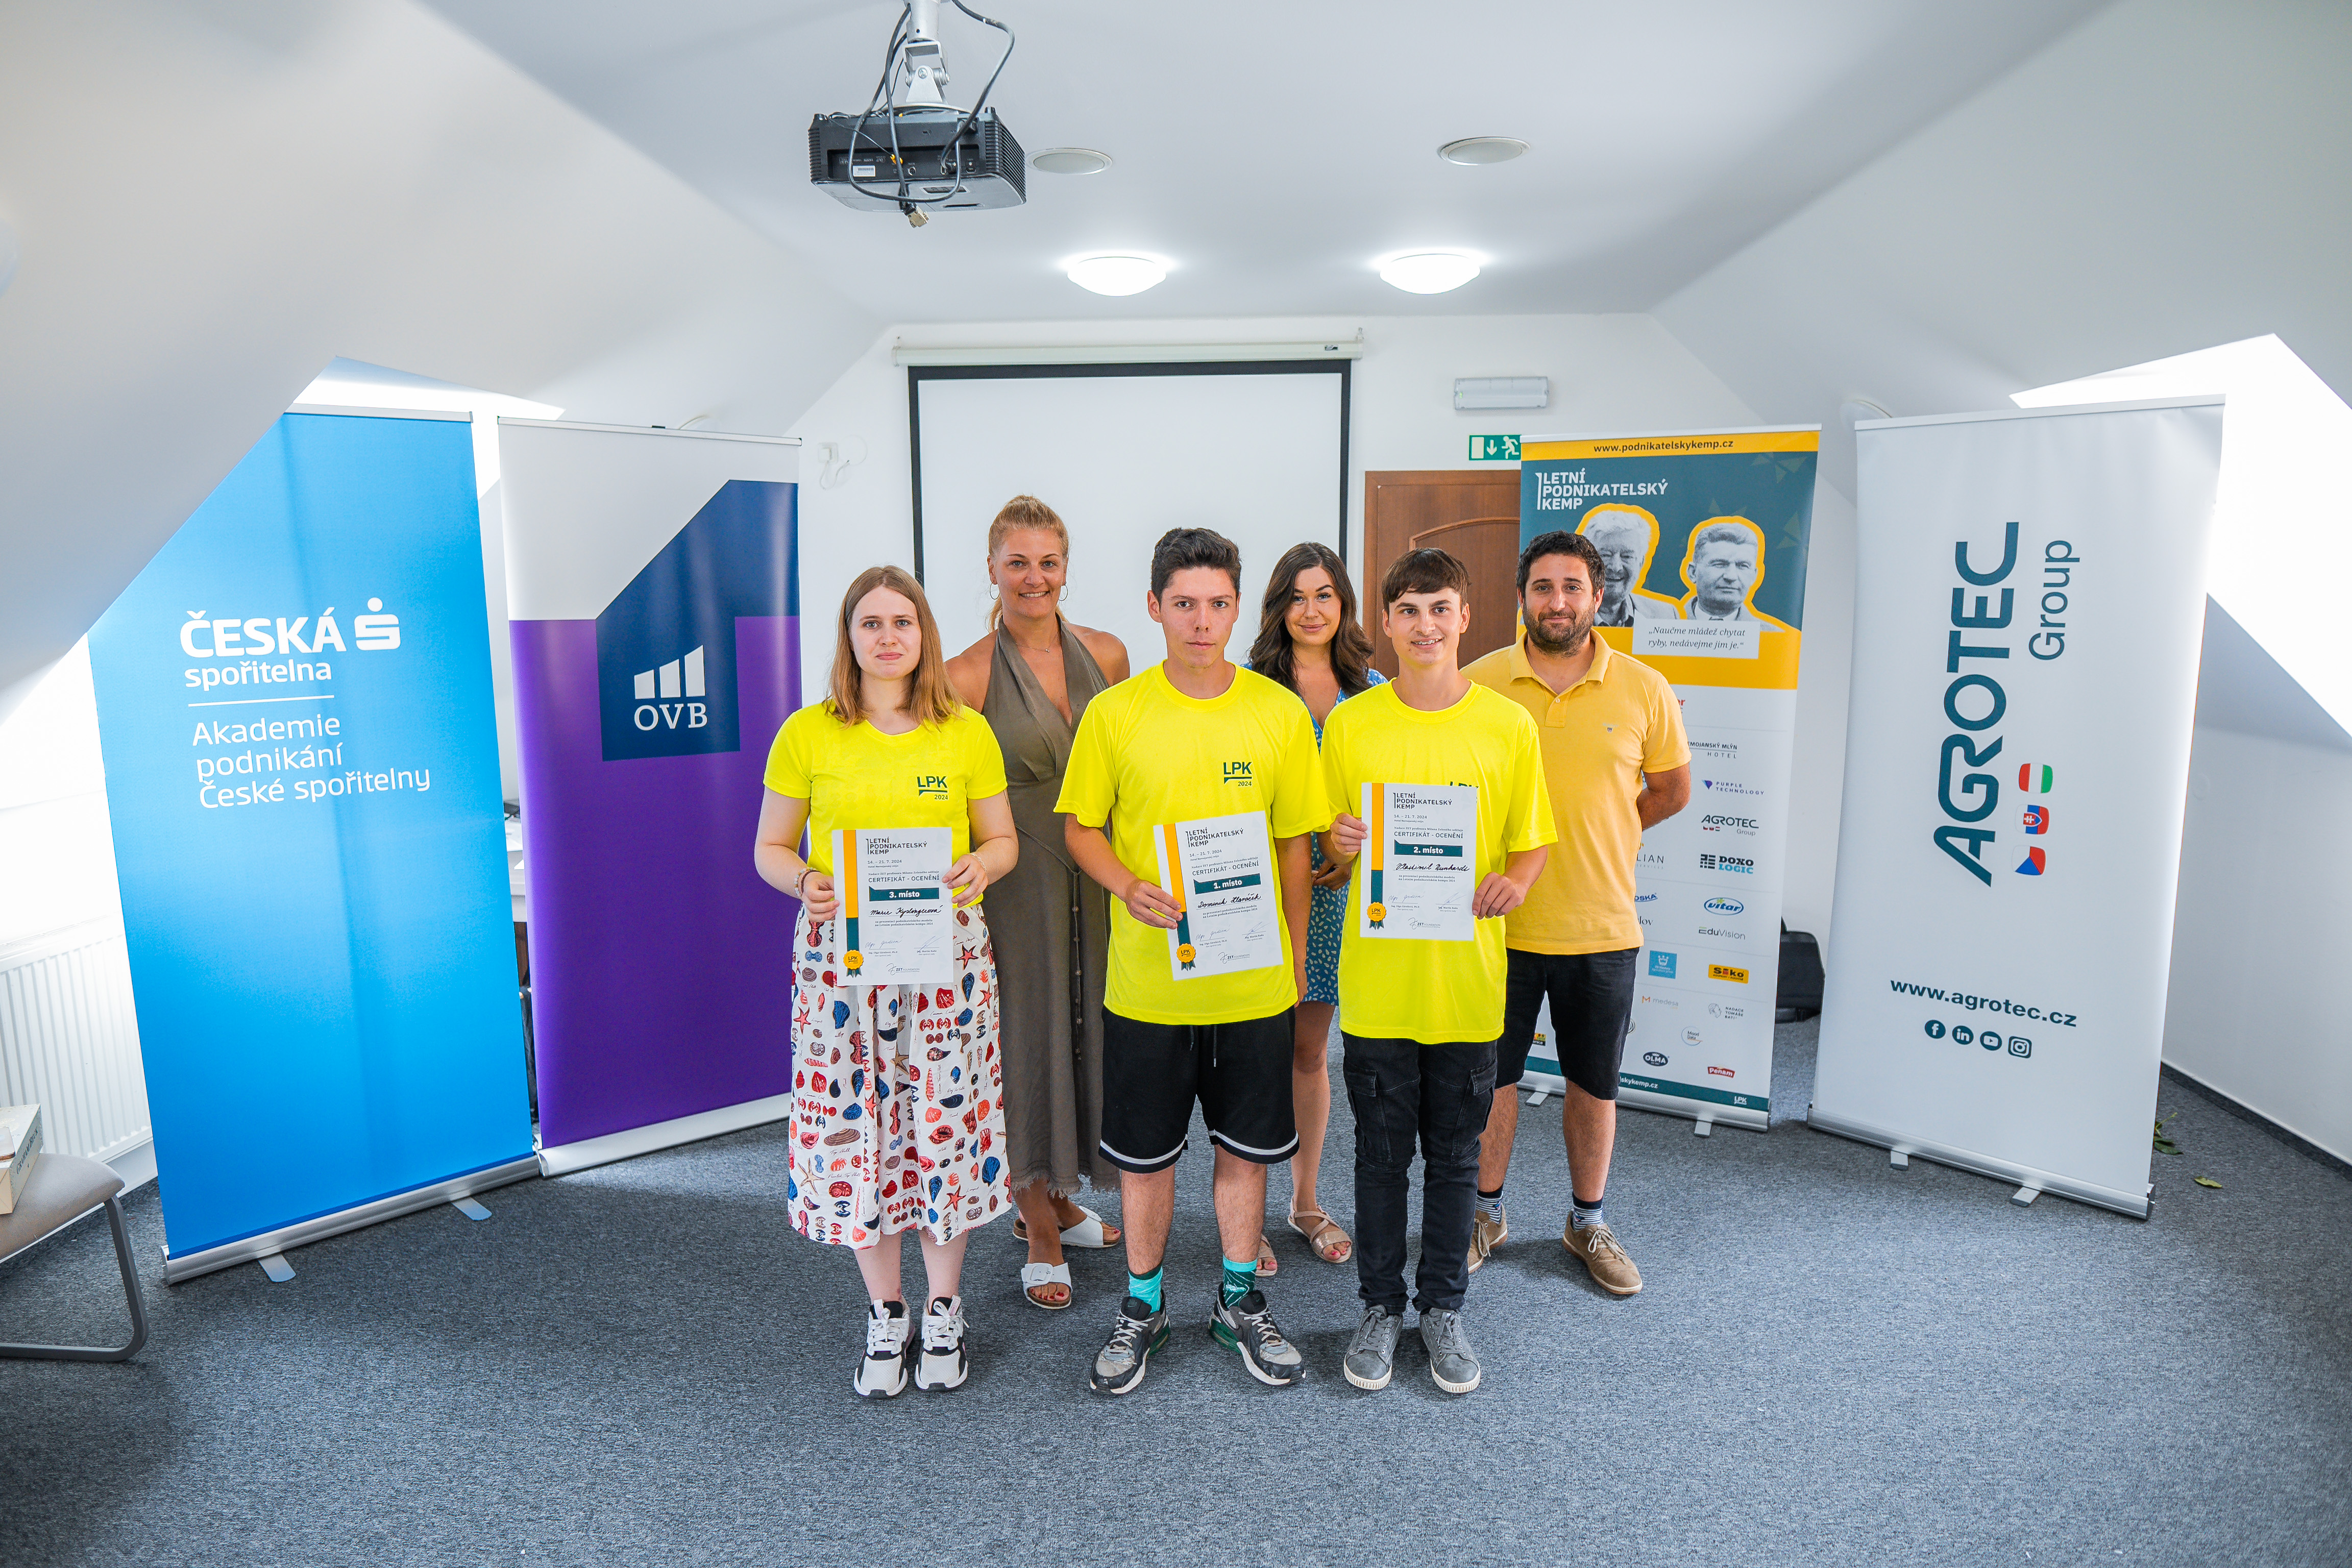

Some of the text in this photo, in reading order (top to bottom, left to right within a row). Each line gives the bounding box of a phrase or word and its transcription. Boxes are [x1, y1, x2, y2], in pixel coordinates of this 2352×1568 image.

[1594, 440, 1733, 453] www.podnikatelskykemp.cz
[1544, 468, 1586, 484] LETNÍ
[1543, 478, 1668, 497] PODNIKATELSKÝ
[1542, 498, 1583, 510] KEMP
[2028, 540, 2080, 660] Group
[180, 607, 347, 658] ČESKÁ
[1688, 627, 1718, 635] mládež
[1720, 628, 1746, 638] chytat
[1648, 639, 1667, 648] ryby,
[1670, 640, 1713, 649] nedávejme
[1713, 641, 1728, 650] jim
[184, 659, 332, 692] spořitelna
[1933, 522, 2019, 887] AGROTEC
[634, 703, 707, 731] OVB
[192, 714, 340, 746] Akademie
[197, 742, 343, 782] podnikání
[1223, 762, 1252, 775] LPK
[200, 768, 430, 808] České spořitelny
[917, 776, 947, 788] LPK
[1716, 787, 1764, 795] TECHNOLOGY
[1701, 815, 1759, 828] AGROTEC
[1189, 827, 1208, 836] LETNÍ
[1190, 827, 1244, 842] PODNIKATELSKÝ
[1736, 828, 1756, 837] Group
[1636, 853, 1664, 864] LIAN
[1719, 855, 1754, 866] DOXO
[1192, 860, 1259, 876] CERTIFIKÁT OCENĚNÍ
[1719, 864, 1754, 874] LOGIC
[1222, 879, 1242, 888] místo
[1197, 898, 1227, 909] Dominik
[1708, 900, 1741, 911] vitar
[1699, 926, 1746, 940] EduVision
[1890, 980, 2077, 1027] www.agrotec.cz
[1645, 1055, 1666, 1064] OLMA
[1709, 1067, 1733, 1077] Penam
[16, 1145, 30, 1174] GRAHAM
